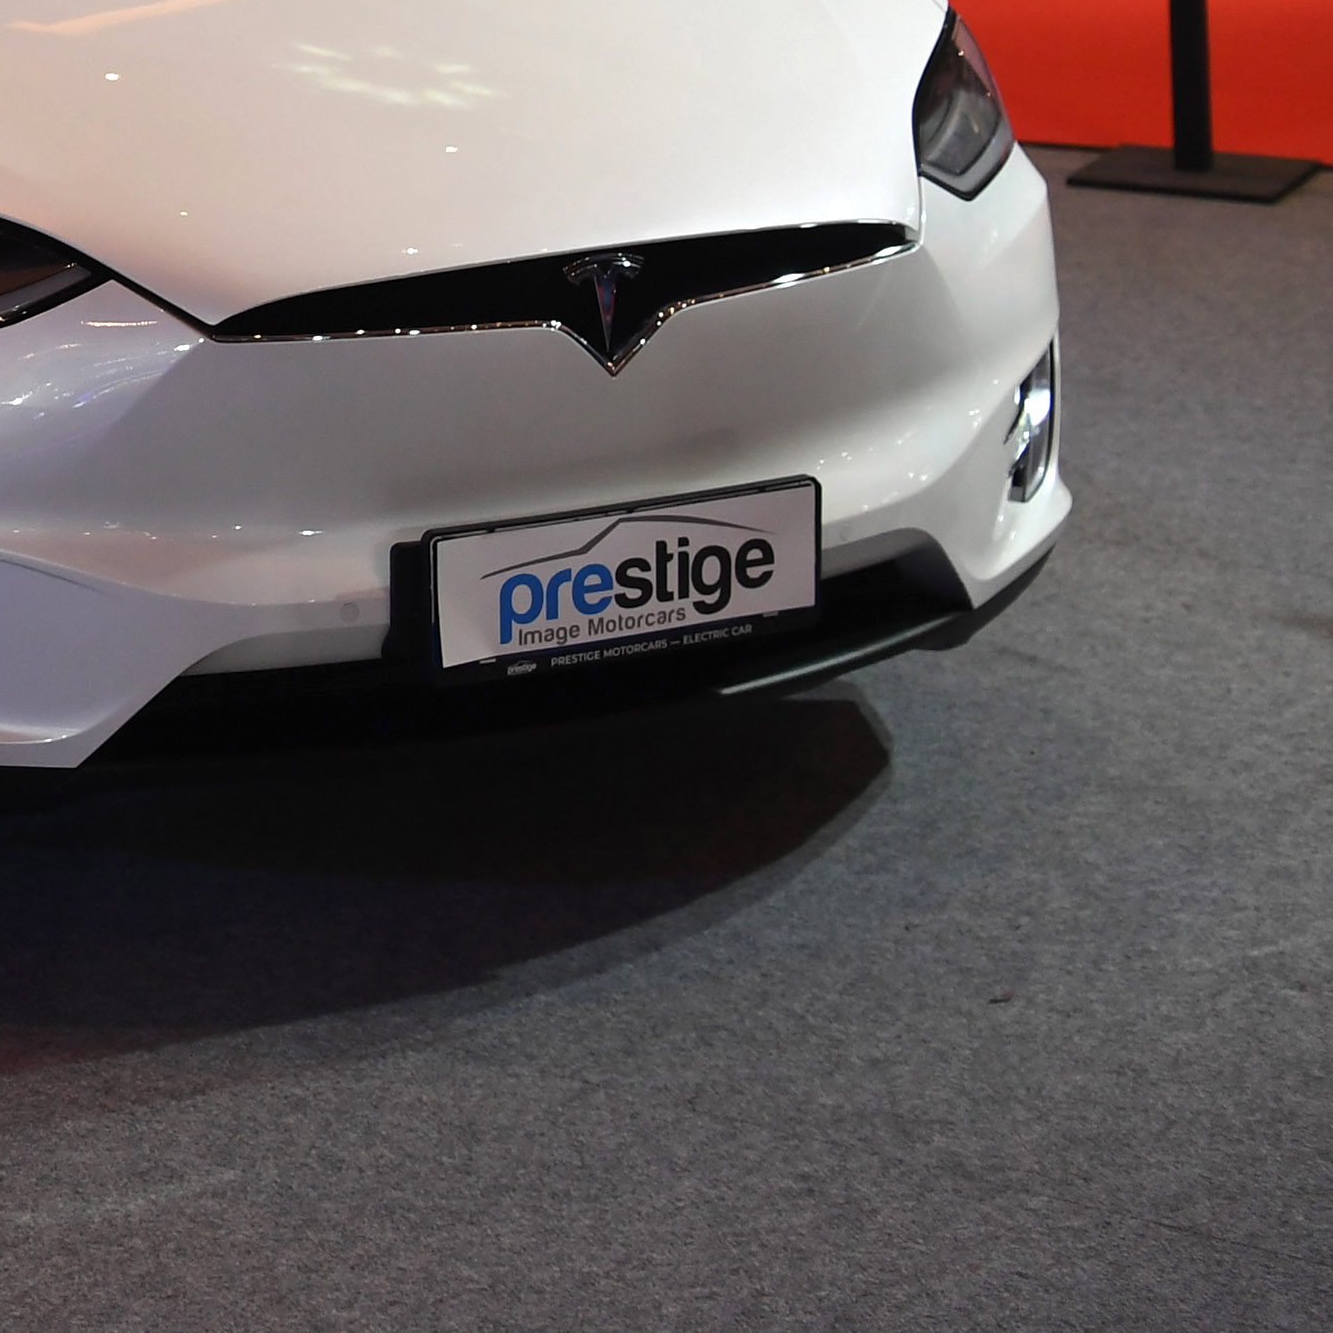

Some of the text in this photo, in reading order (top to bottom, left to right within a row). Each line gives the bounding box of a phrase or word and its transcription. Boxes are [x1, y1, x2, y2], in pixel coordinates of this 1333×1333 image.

[498, 536, 775, 645] prestige
[518, 607, 687, 646] Image Motorcars
[550, 649, 601, 667] PRESTIGE
[603, 638, 668, 658] MOTORCARS
[683, 627, 731, 645] ELECTRIC
[731, 624, 753, 636] CAR
